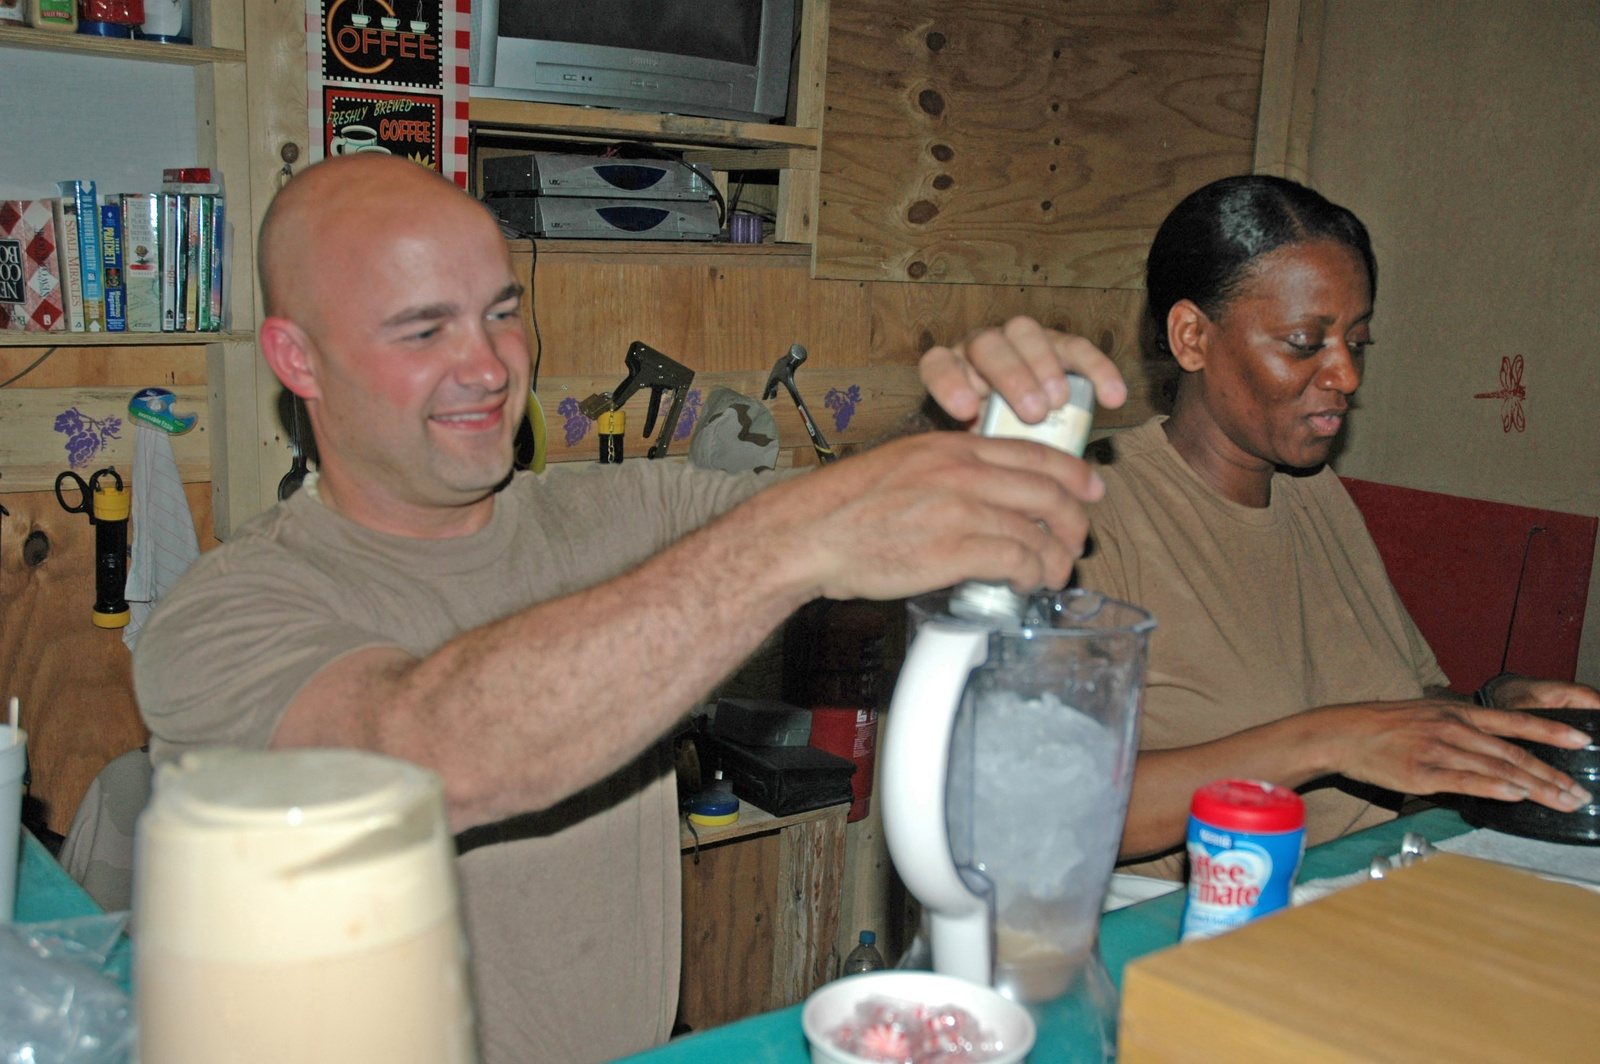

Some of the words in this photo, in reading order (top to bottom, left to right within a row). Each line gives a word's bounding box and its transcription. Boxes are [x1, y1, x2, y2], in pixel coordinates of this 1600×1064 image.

[327, 106, 368, 126] FRESHLY
[374, 99, 412, 116] BREWED
[380, 118, 431, 143] COFFEE
[65, 220, 78, 254] SMALL
[103, 226, 116, 264] PRATCHETT
[68, 256, 81, 307] MIRACLES
[1199, 882, 1260, 907] mate
